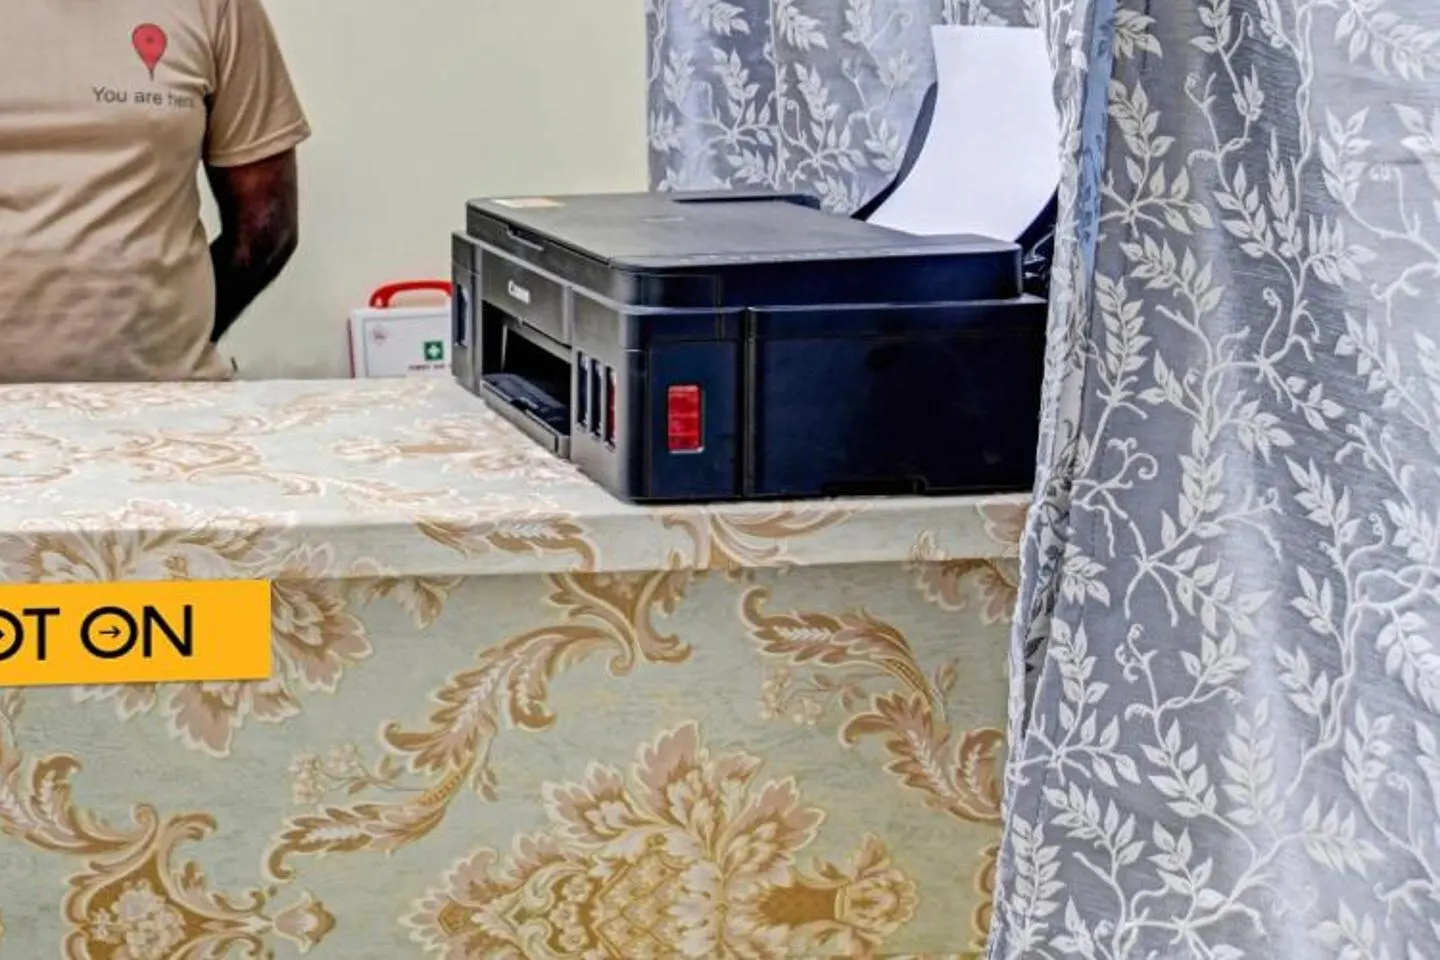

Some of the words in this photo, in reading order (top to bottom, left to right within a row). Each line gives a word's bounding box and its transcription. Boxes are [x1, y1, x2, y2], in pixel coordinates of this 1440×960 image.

[92, 86, 127, 103] You
[134, 91, 163, 105] are
[80, 604, 193, 659] ON
